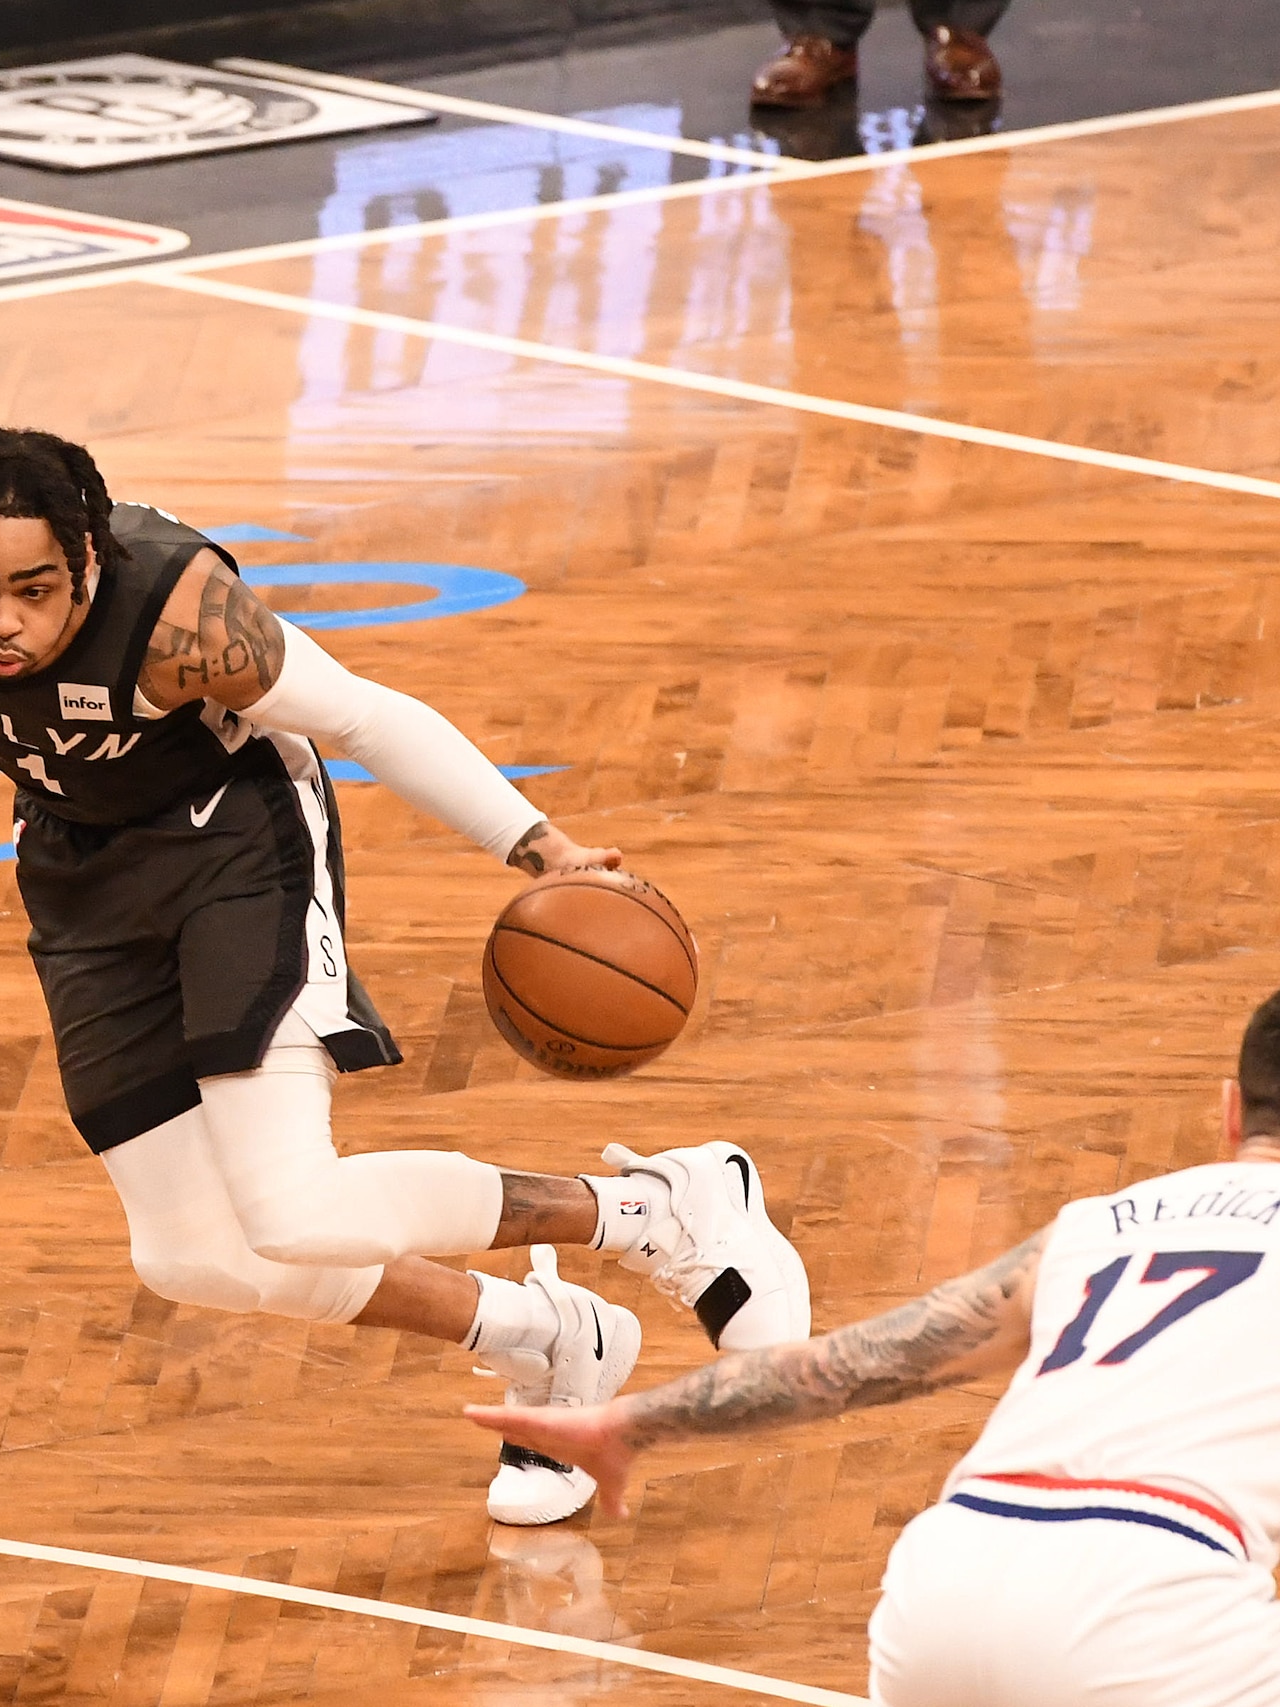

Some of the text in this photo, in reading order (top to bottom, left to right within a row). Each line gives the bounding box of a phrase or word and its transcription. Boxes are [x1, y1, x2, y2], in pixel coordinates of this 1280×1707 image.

[63, 696, 107, 711] infor
[16, 753, 67, 797] 1
[1035, 1251, 1266, 1378] 17
